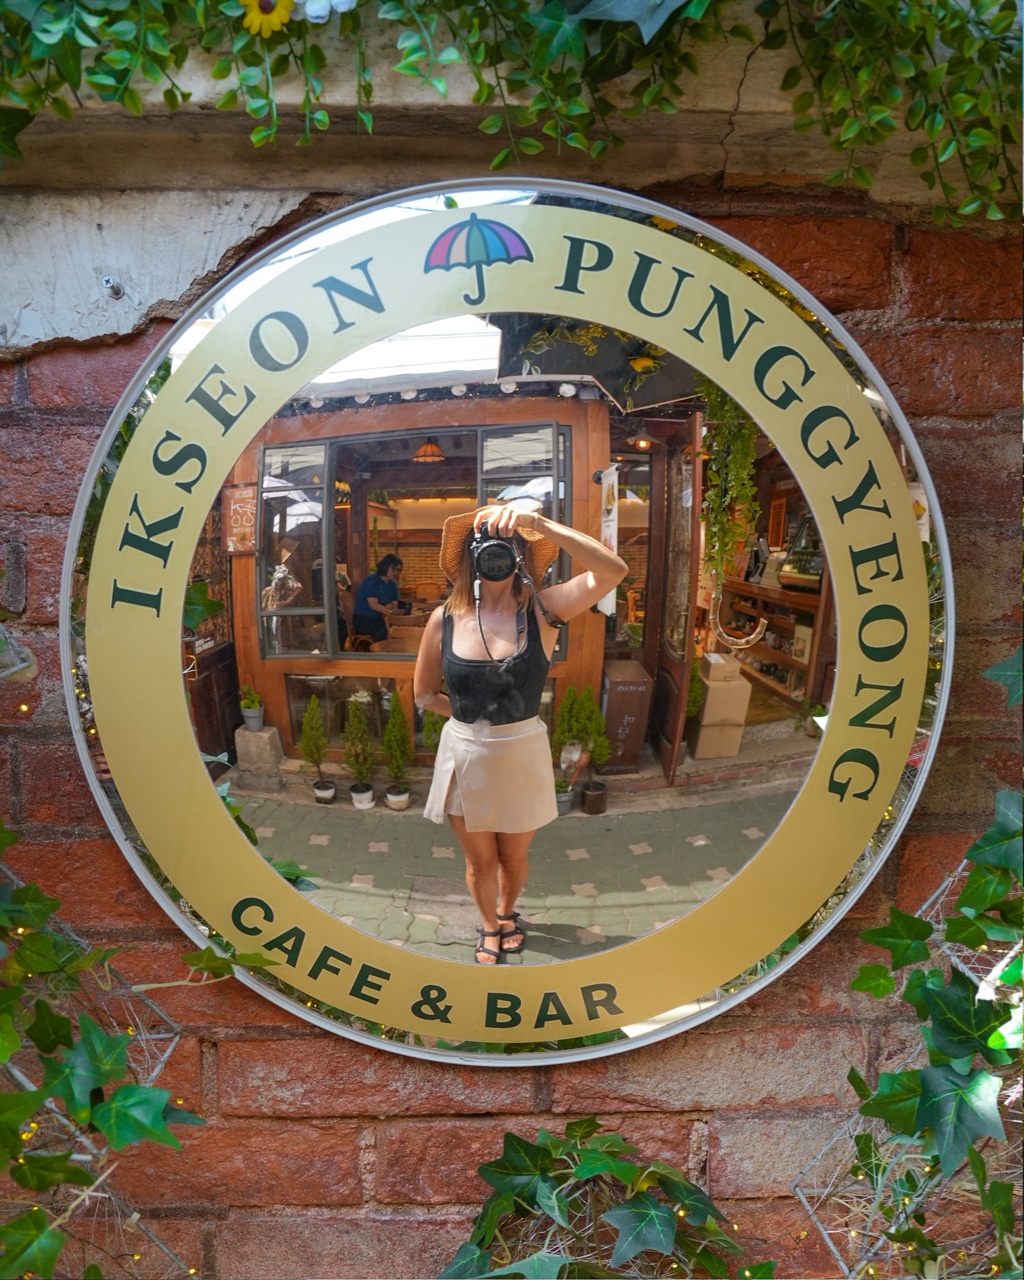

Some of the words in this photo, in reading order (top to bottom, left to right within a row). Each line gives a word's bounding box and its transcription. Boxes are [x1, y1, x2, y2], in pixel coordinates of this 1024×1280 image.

[111, 256, 386, 618] IKSEON
[554, 236, 908, 802] PUNGGYEONG
[231, 897, 391, 1005] CAFE
[411, 985, 453, 1024] &
[485, 984, 623, 1029] BAR
